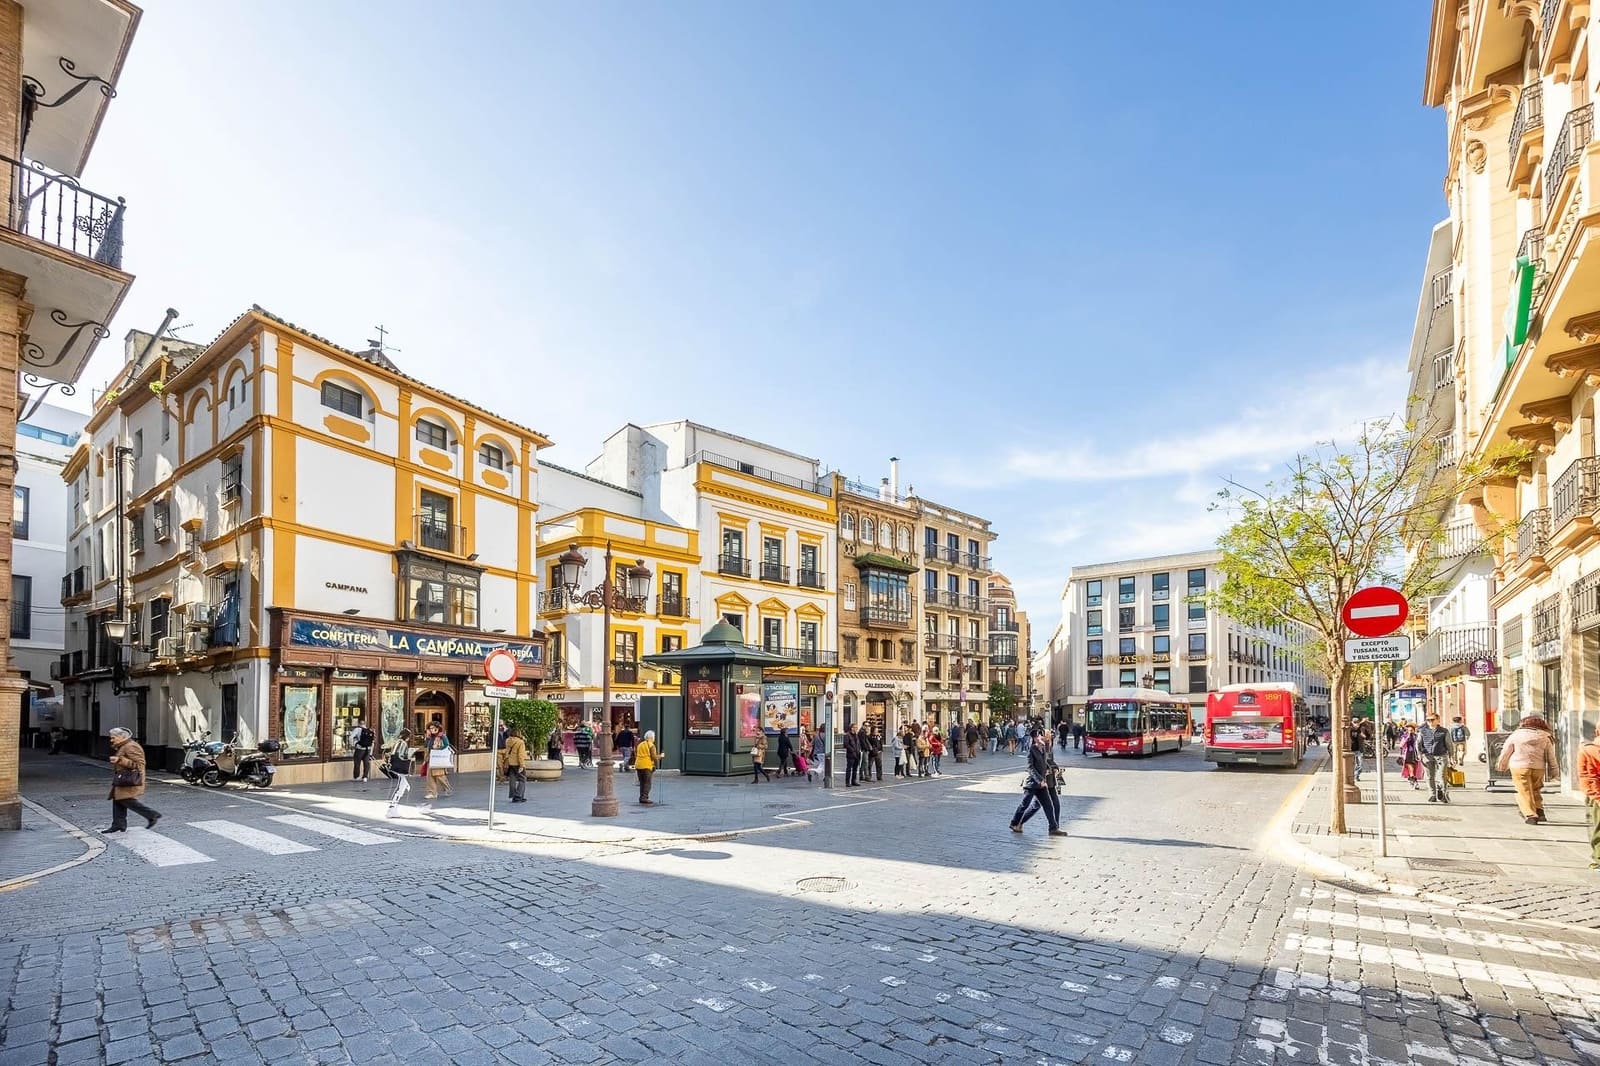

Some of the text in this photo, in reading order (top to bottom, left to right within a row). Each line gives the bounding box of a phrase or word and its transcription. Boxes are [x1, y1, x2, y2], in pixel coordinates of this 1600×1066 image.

[325, 582, 368, 594] CAMPANA
[312, 630, 378, 645] CONFITERIA
[389, 634, 410, 650] LA
[416, 638, 483, 657] CAMPANA
[1264, 693, 1282, 701] 1891
